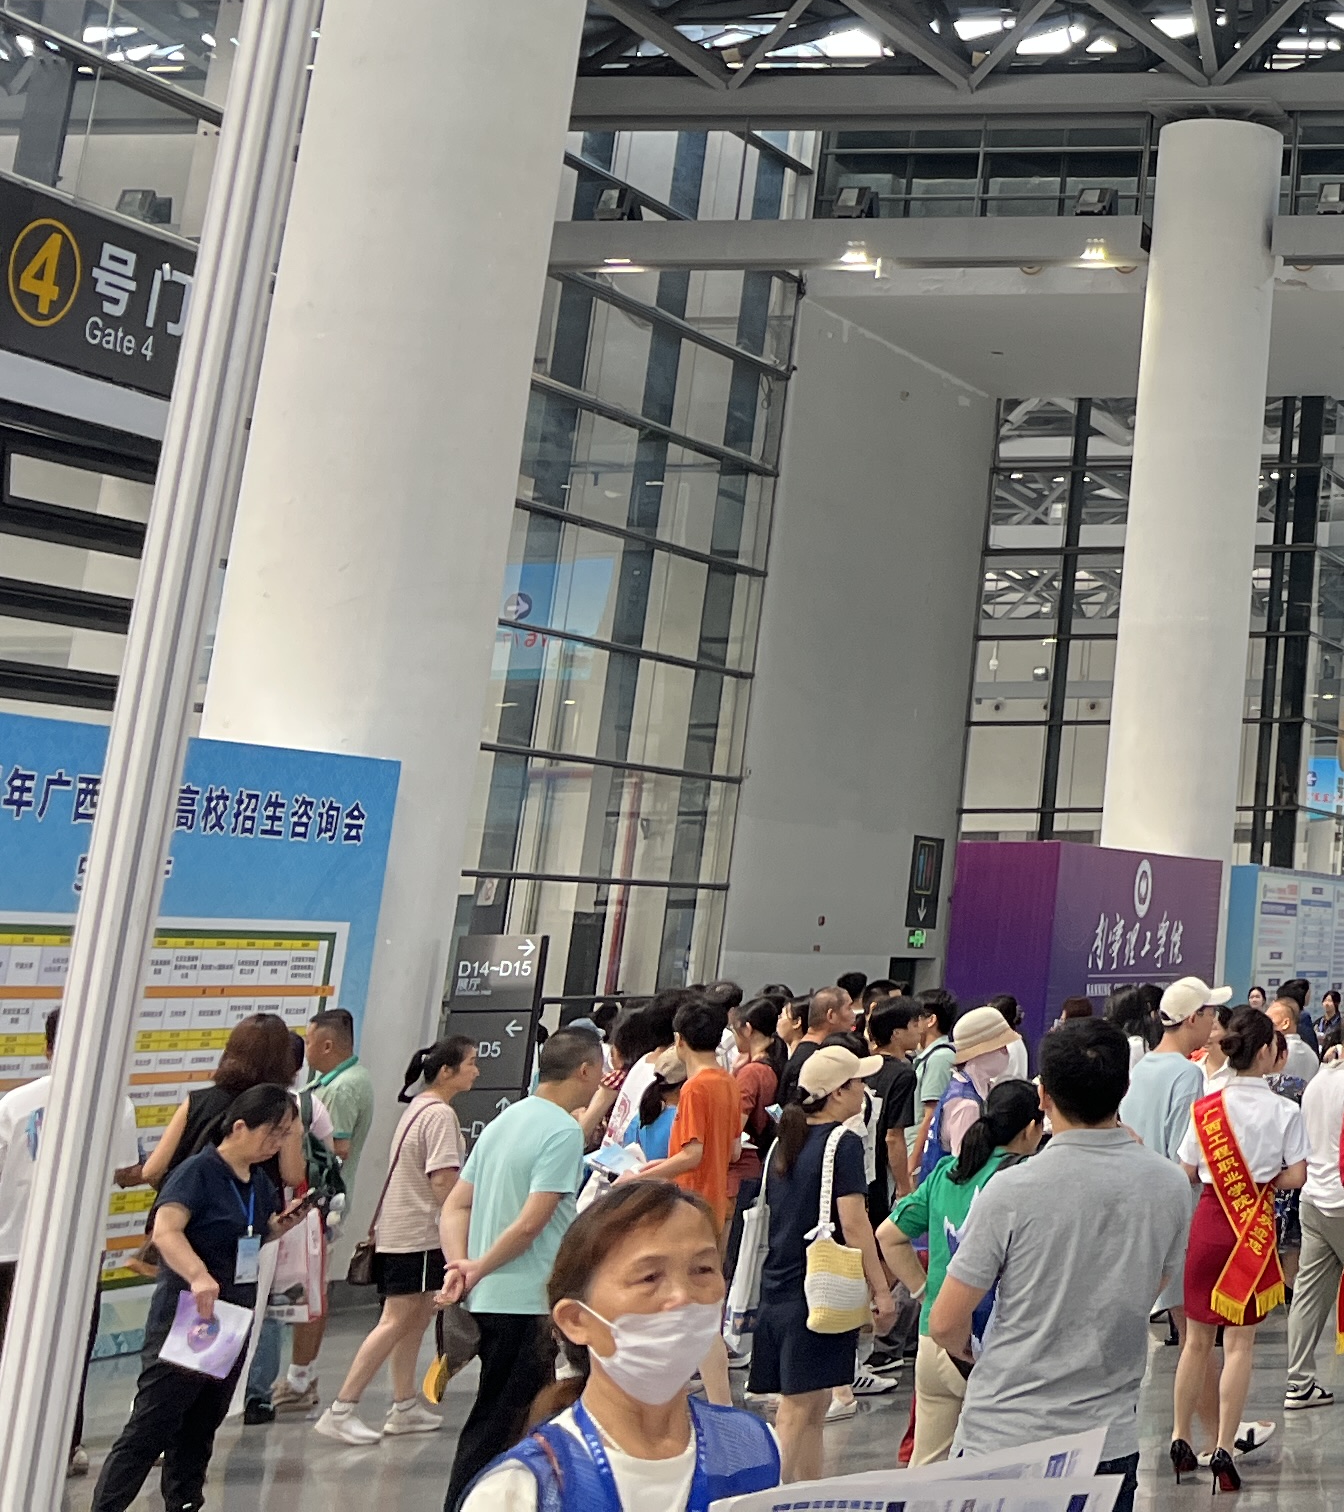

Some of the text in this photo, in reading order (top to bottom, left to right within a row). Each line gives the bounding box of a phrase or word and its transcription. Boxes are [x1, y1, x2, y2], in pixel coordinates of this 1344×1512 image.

[85, 316, 154, 361] Gate 4
[458, 960, 532, 977] D14~D15
